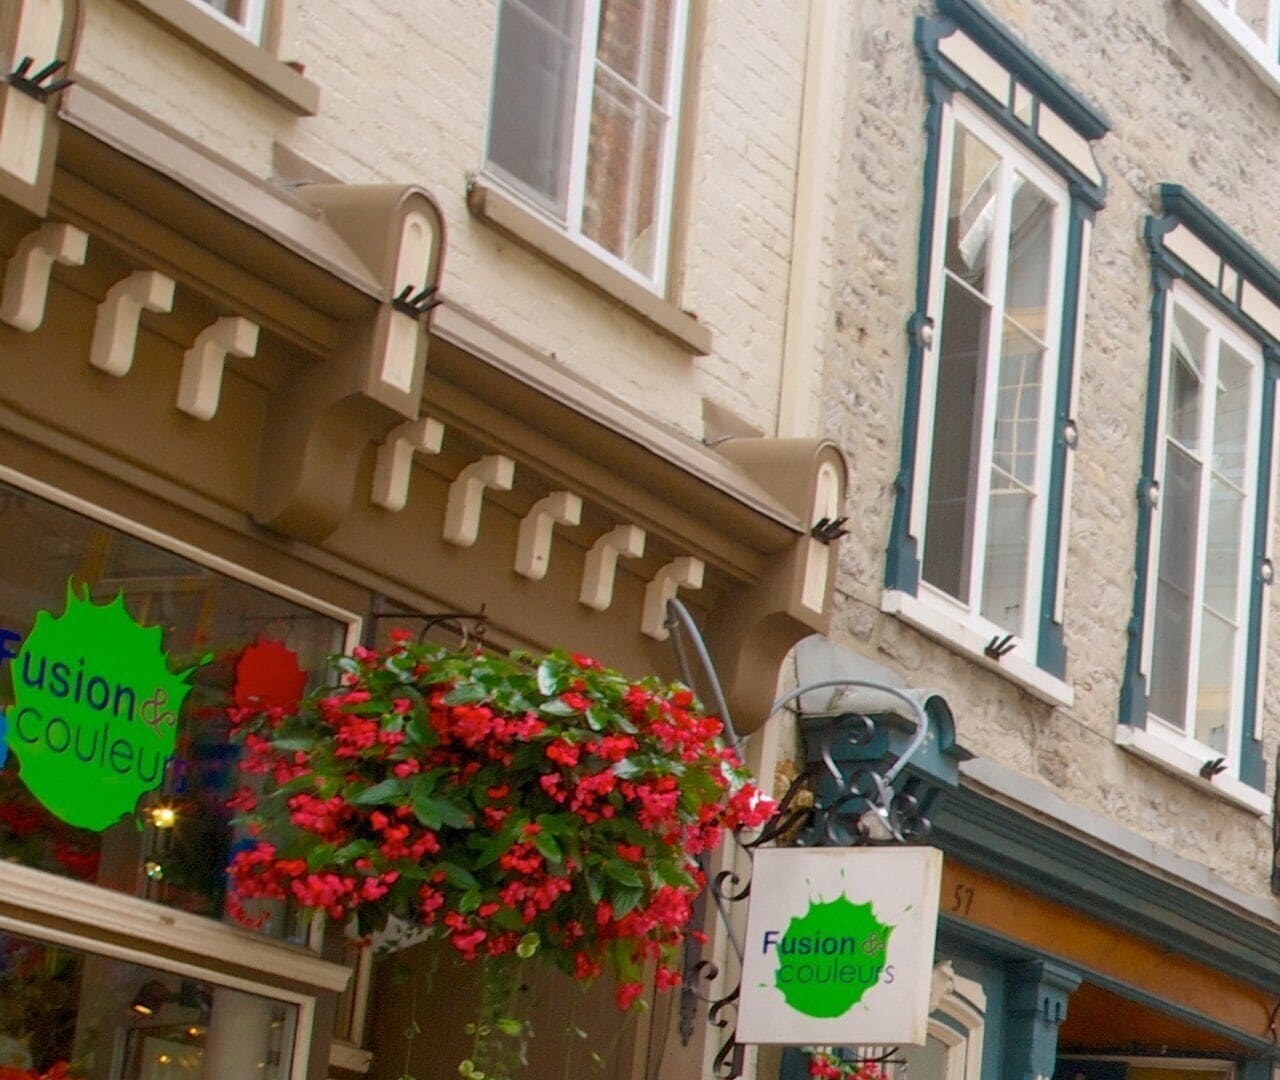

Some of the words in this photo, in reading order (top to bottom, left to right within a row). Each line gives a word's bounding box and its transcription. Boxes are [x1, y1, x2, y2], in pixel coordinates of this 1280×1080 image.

[951, 884, 975, 916] 57
[763, 930, 855, 955] Fusion
[775, 959, 895, 984] couleurs
